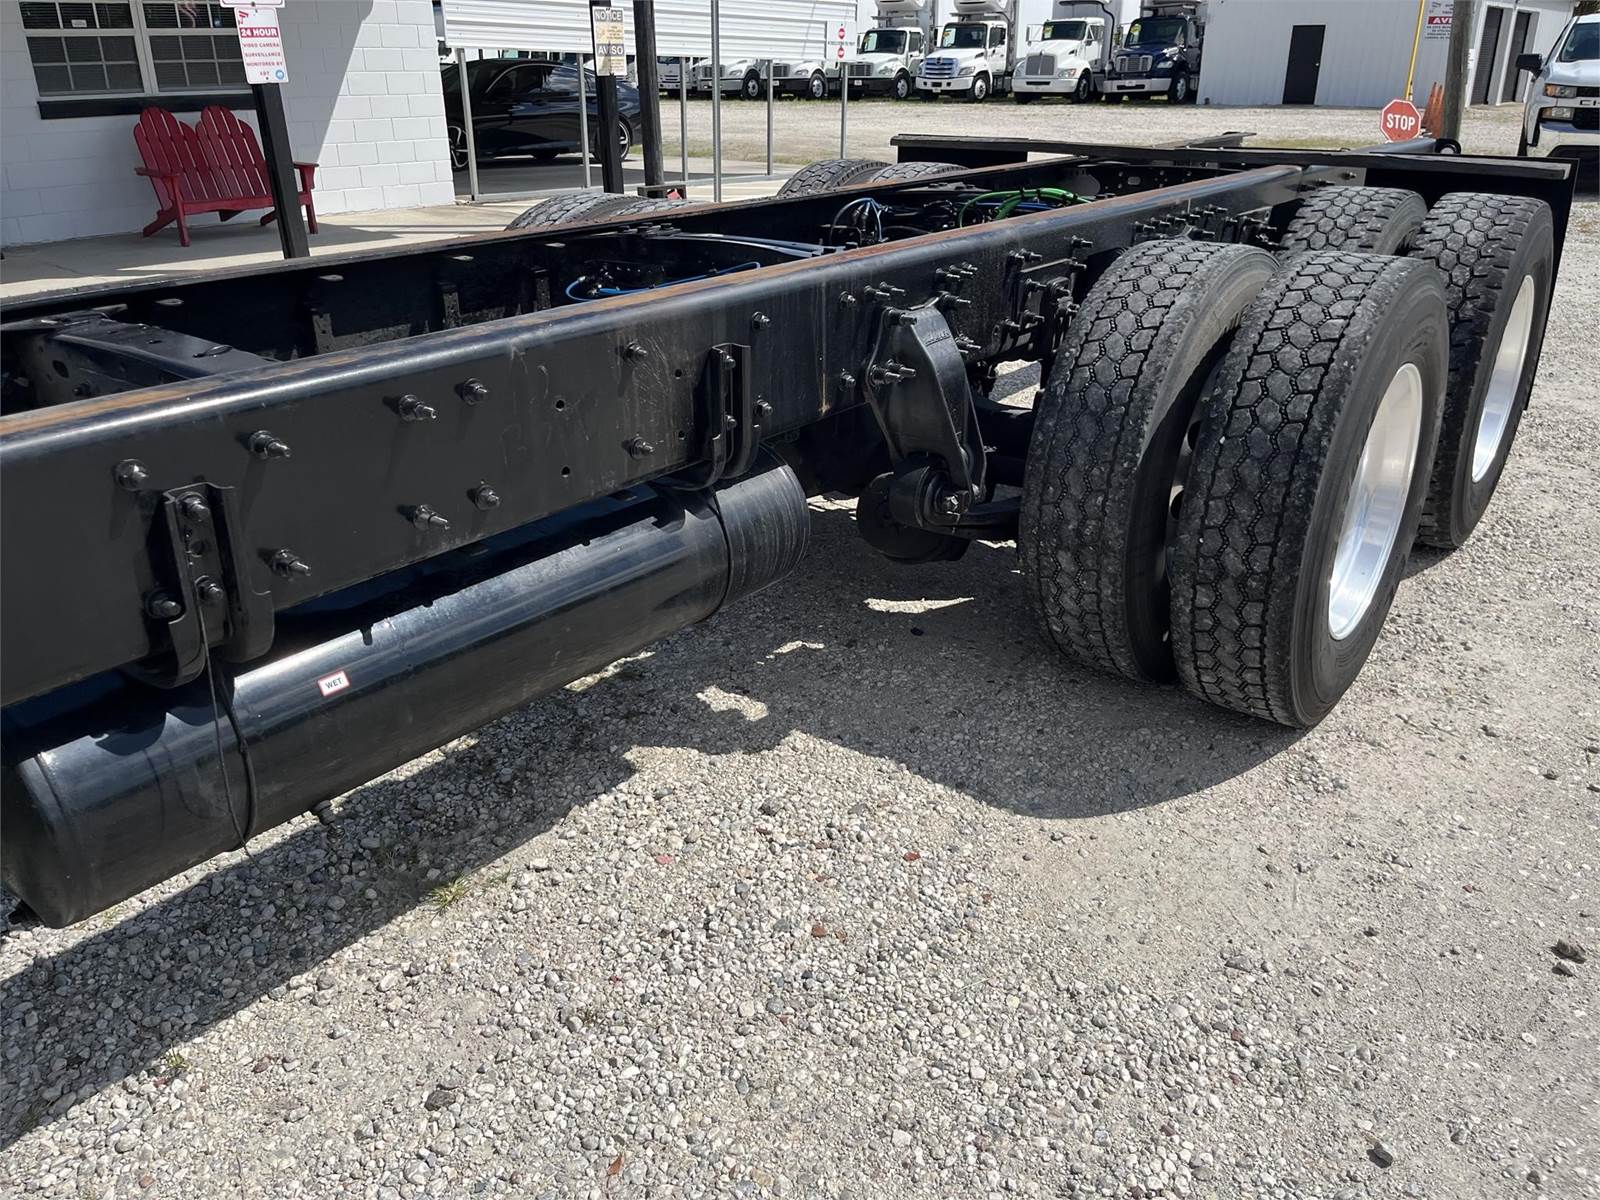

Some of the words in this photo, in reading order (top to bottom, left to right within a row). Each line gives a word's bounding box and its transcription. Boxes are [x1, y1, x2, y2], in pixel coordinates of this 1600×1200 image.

[595, 11, 622, 20] NOTICE
[598, 46, 624, 54] AVISO
[1386, 113, 1416, 130] STOP
[325, 678, 342, 688] WET
